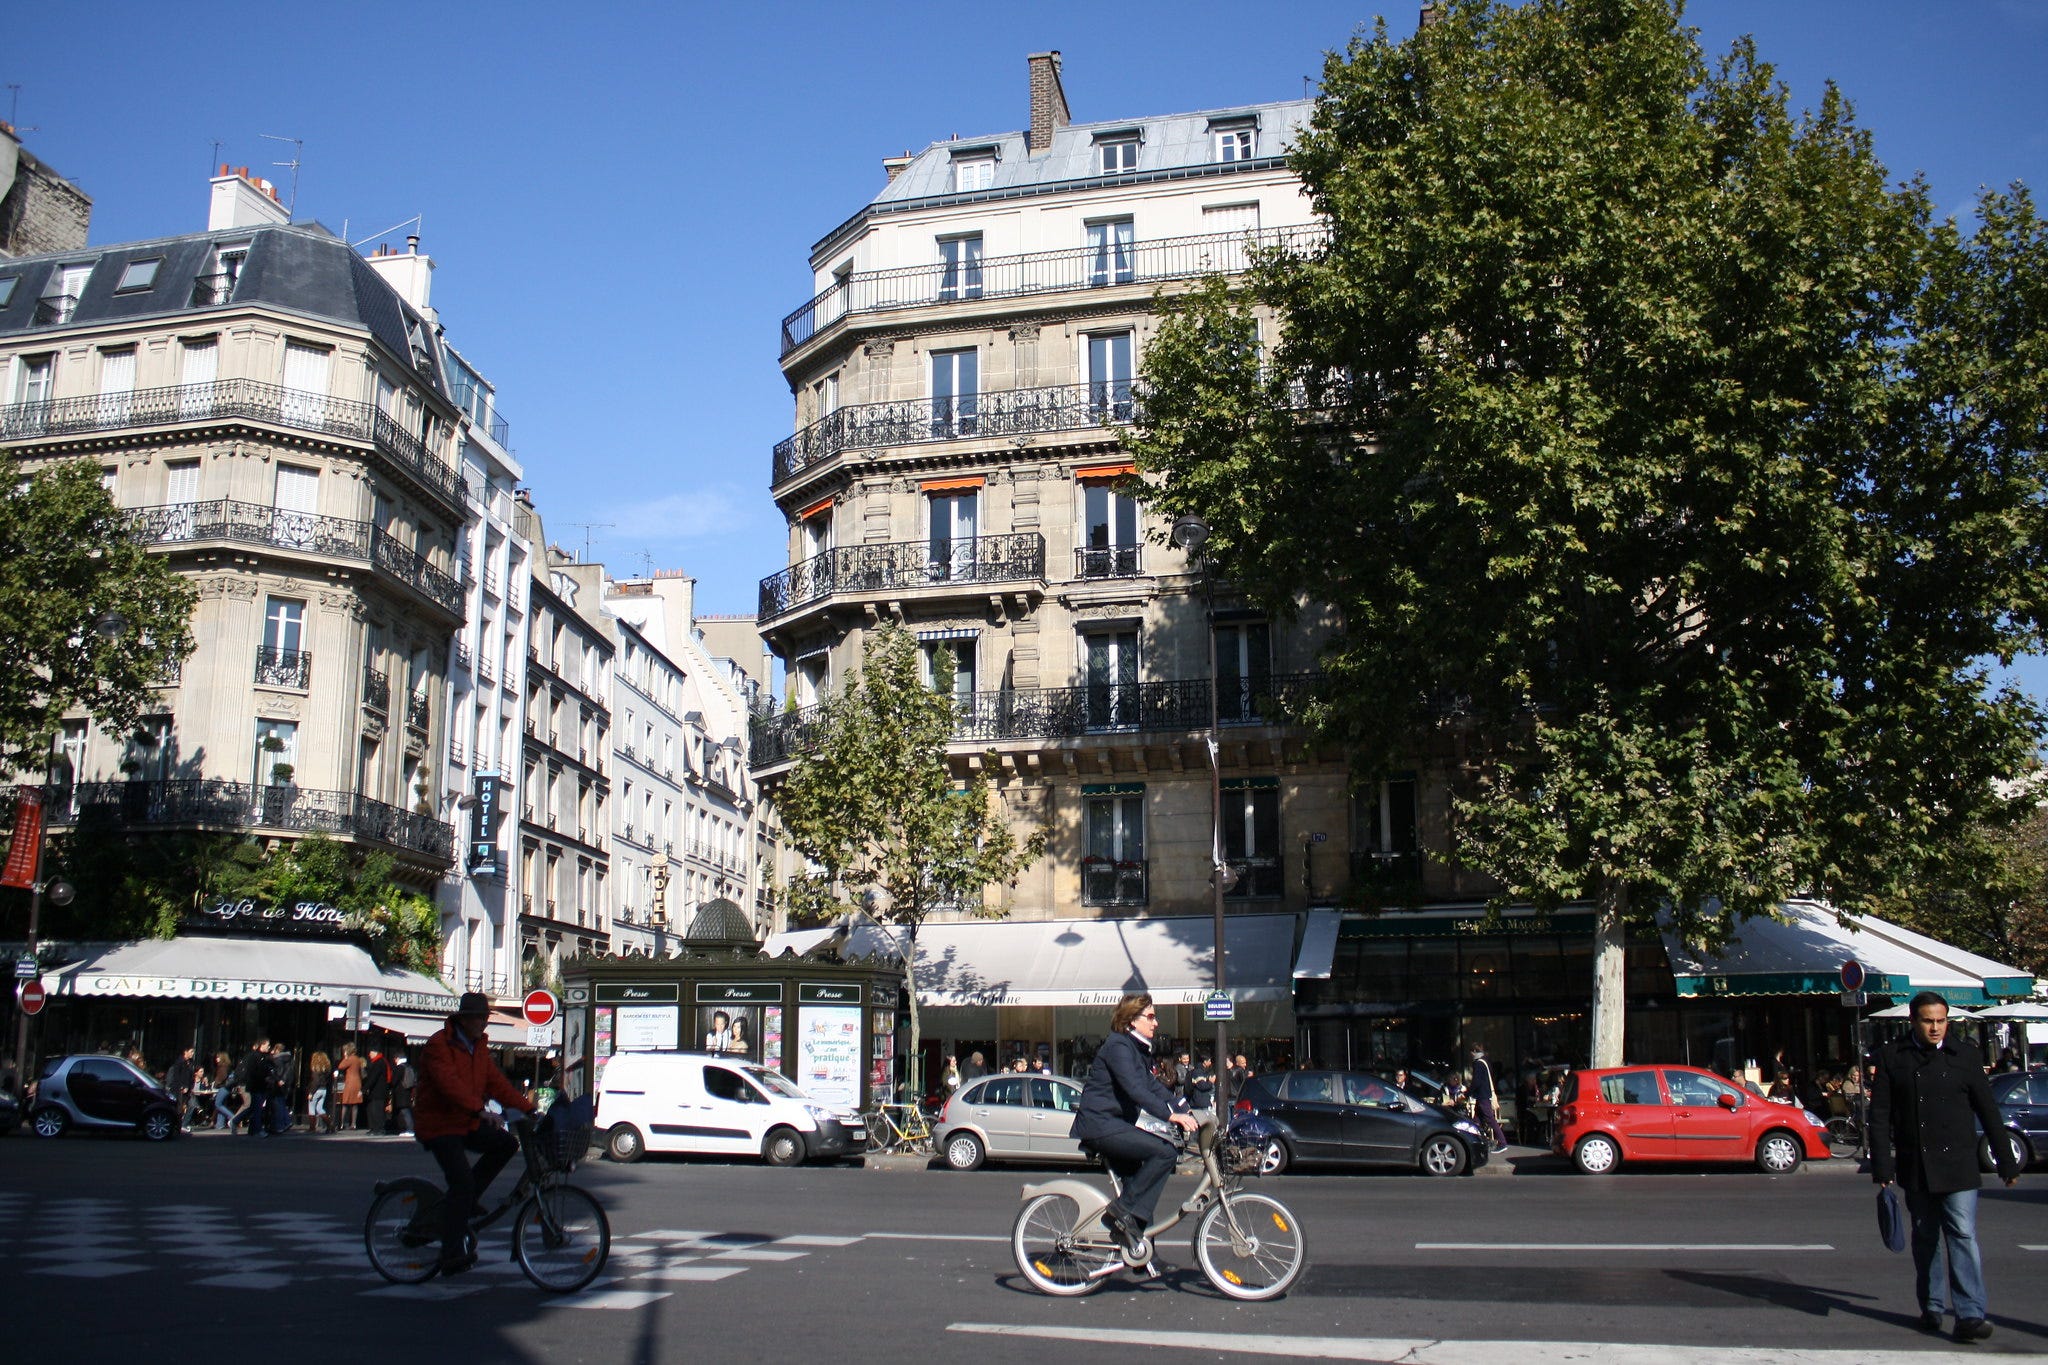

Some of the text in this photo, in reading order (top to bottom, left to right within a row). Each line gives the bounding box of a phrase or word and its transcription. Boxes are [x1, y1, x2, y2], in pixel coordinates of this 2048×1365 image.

[481, 781, 492, 837] HOTEL
[653, 866, 666, 924] HOTEL
[202, 897, 349, 922] Café de Flore
[190, 979, 229, 994] DE
[241, 982, 322, 997] FLORE
[623, 988, 650, 999] Presse
[724, 987, 752, 998] Presse
[816, 988, 843, 999] Presse
[384, 990, 461, 1008] CAFE DE FLOR
[977, 993, 1021, 1004] la hune
[1078, 993, 1090, 1003] la
[1182, 991, 1193, 1002] la
[813, 1054, 850, 1064] pratique
